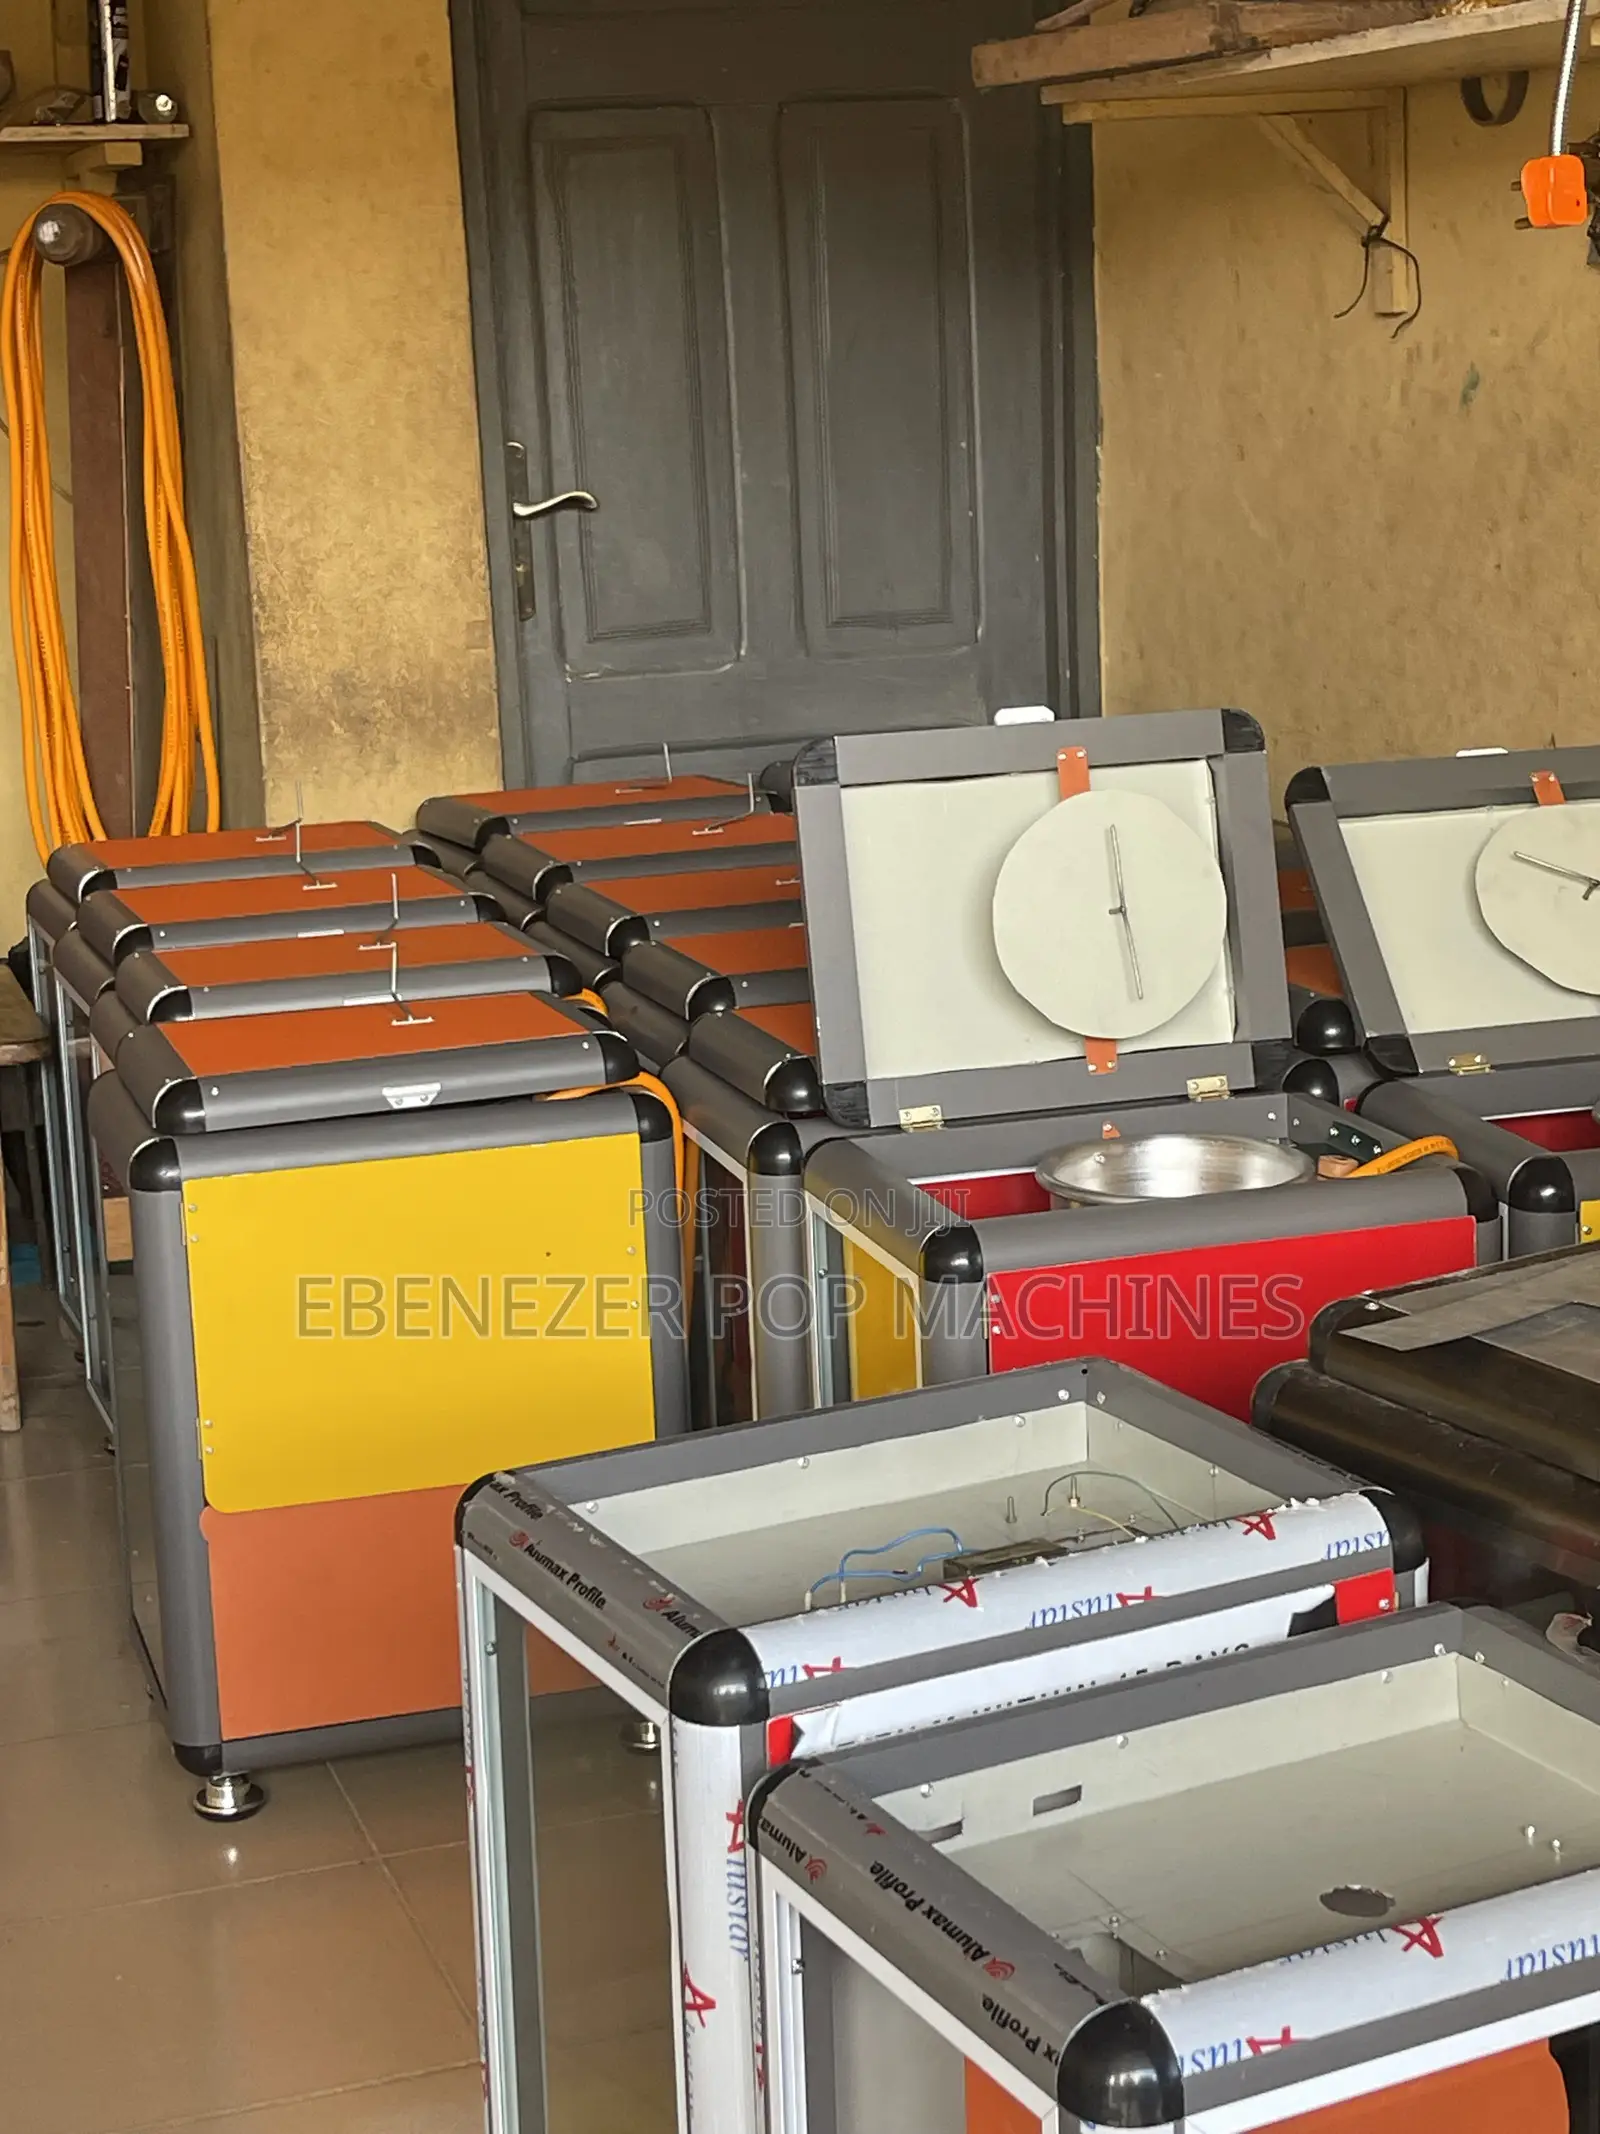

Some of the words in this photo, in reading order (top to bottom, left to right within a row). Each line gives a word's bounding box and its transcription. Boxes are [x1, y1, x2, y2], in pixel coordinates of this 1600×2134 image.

[565, 1573, 607, 1611] Profile
[757, 1817, 806, 1863] Aluma
[870, 1859, 924, 1912] Profile
[922, 1906, 991, 1963] Alumax
[980, 1992, 1039, 2053] Profile
